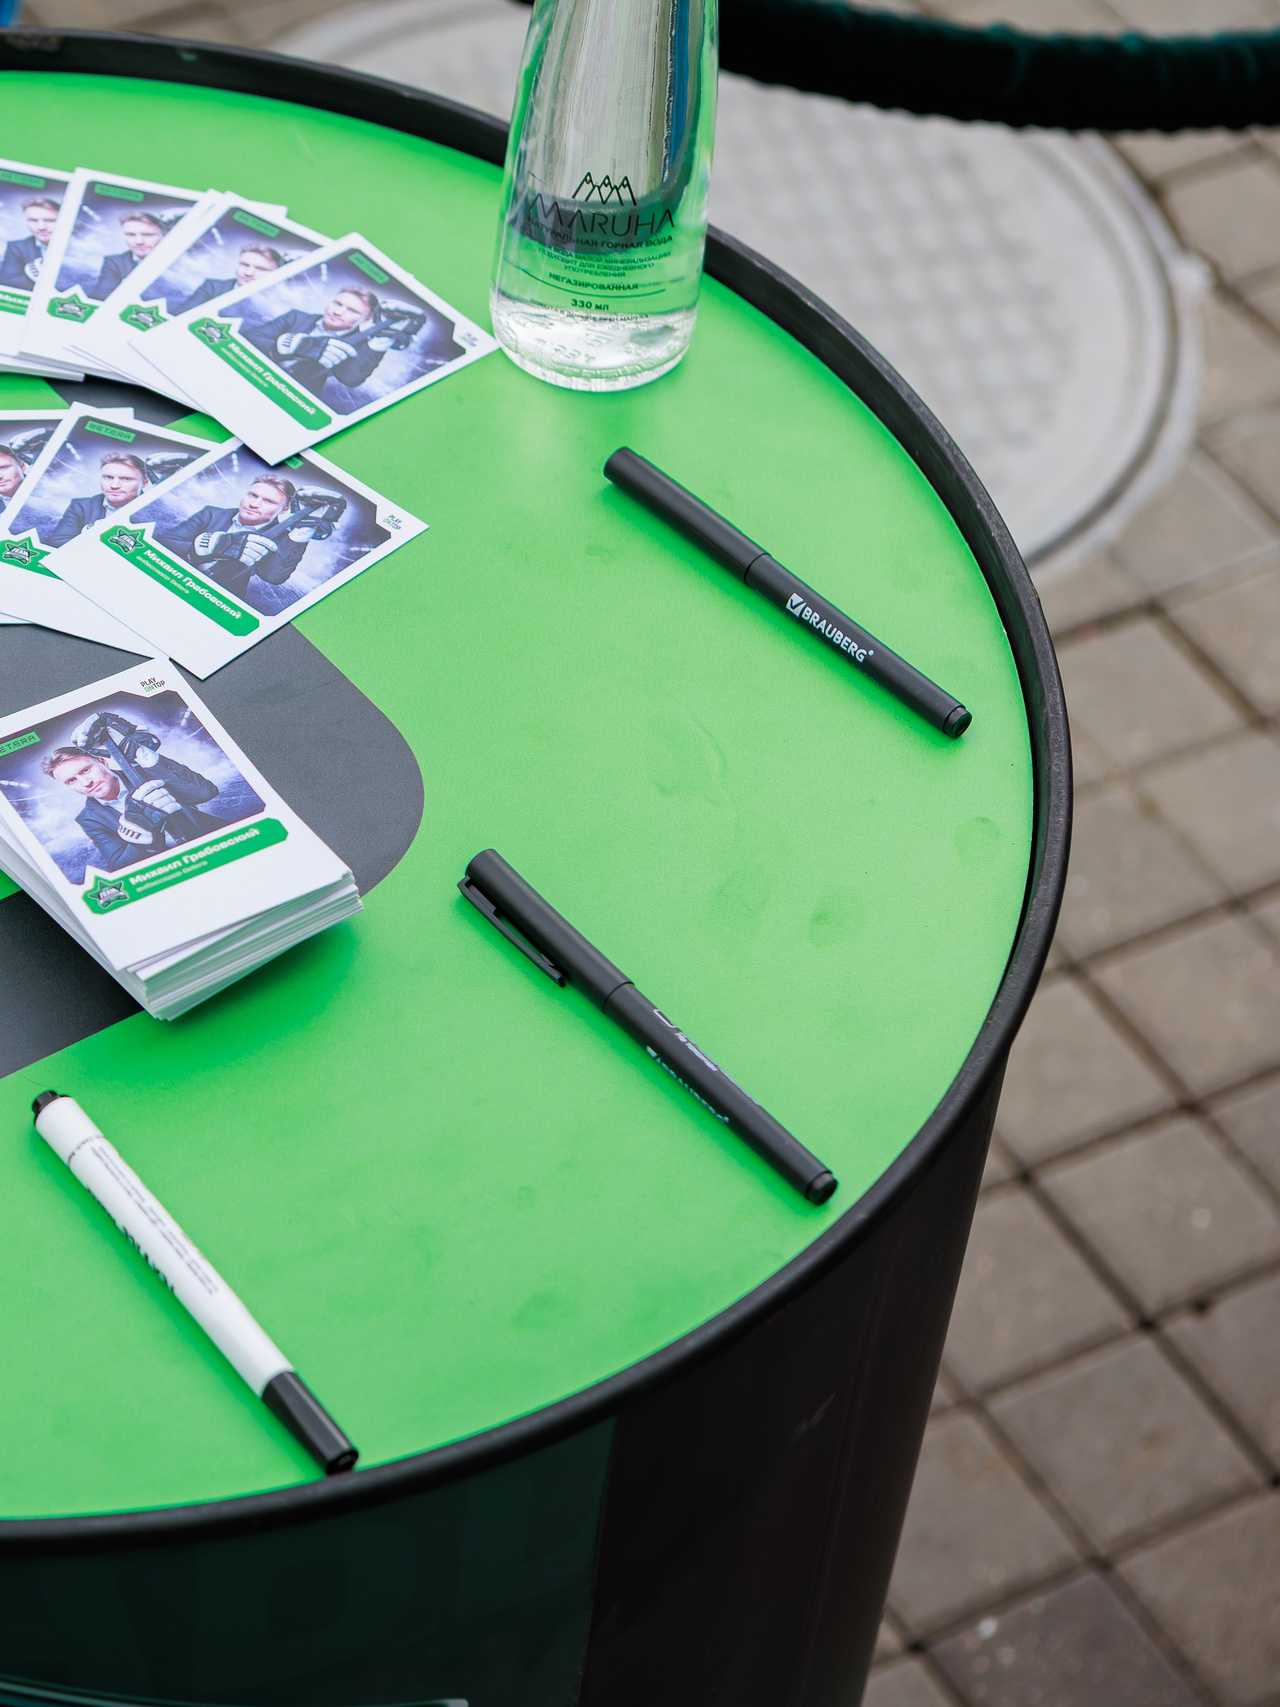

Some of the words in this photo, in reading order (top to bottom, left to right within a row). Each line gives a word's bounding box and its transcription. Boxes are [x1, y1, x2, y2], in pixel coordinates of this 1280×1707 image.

[530, 193, 674, 237] MARUHA
[601, 241, 642, 249] ГОРНАЯ
[645, 235, 673, 247] ВОДА
[538, 247, 578, 266] ПОДХОДИТ
[597, 262, 655, 271] ЕЖЕДНЕВНОГО
[564, 264, 626, 278] УПОТРЕБЛЕНИЯ
[549, 272, 639, 291] НЕГАЗИРОВАННАЯ
[571, 298, 592, 310] 330
[143, 549, 184, 579] Михаил
[181, 575, 243, 620] Грабовский
[140, 676, 157, 688] PLAY
[128, 859, 183, 886] Михаил
[181, 827, 261, 865] Грабовский
